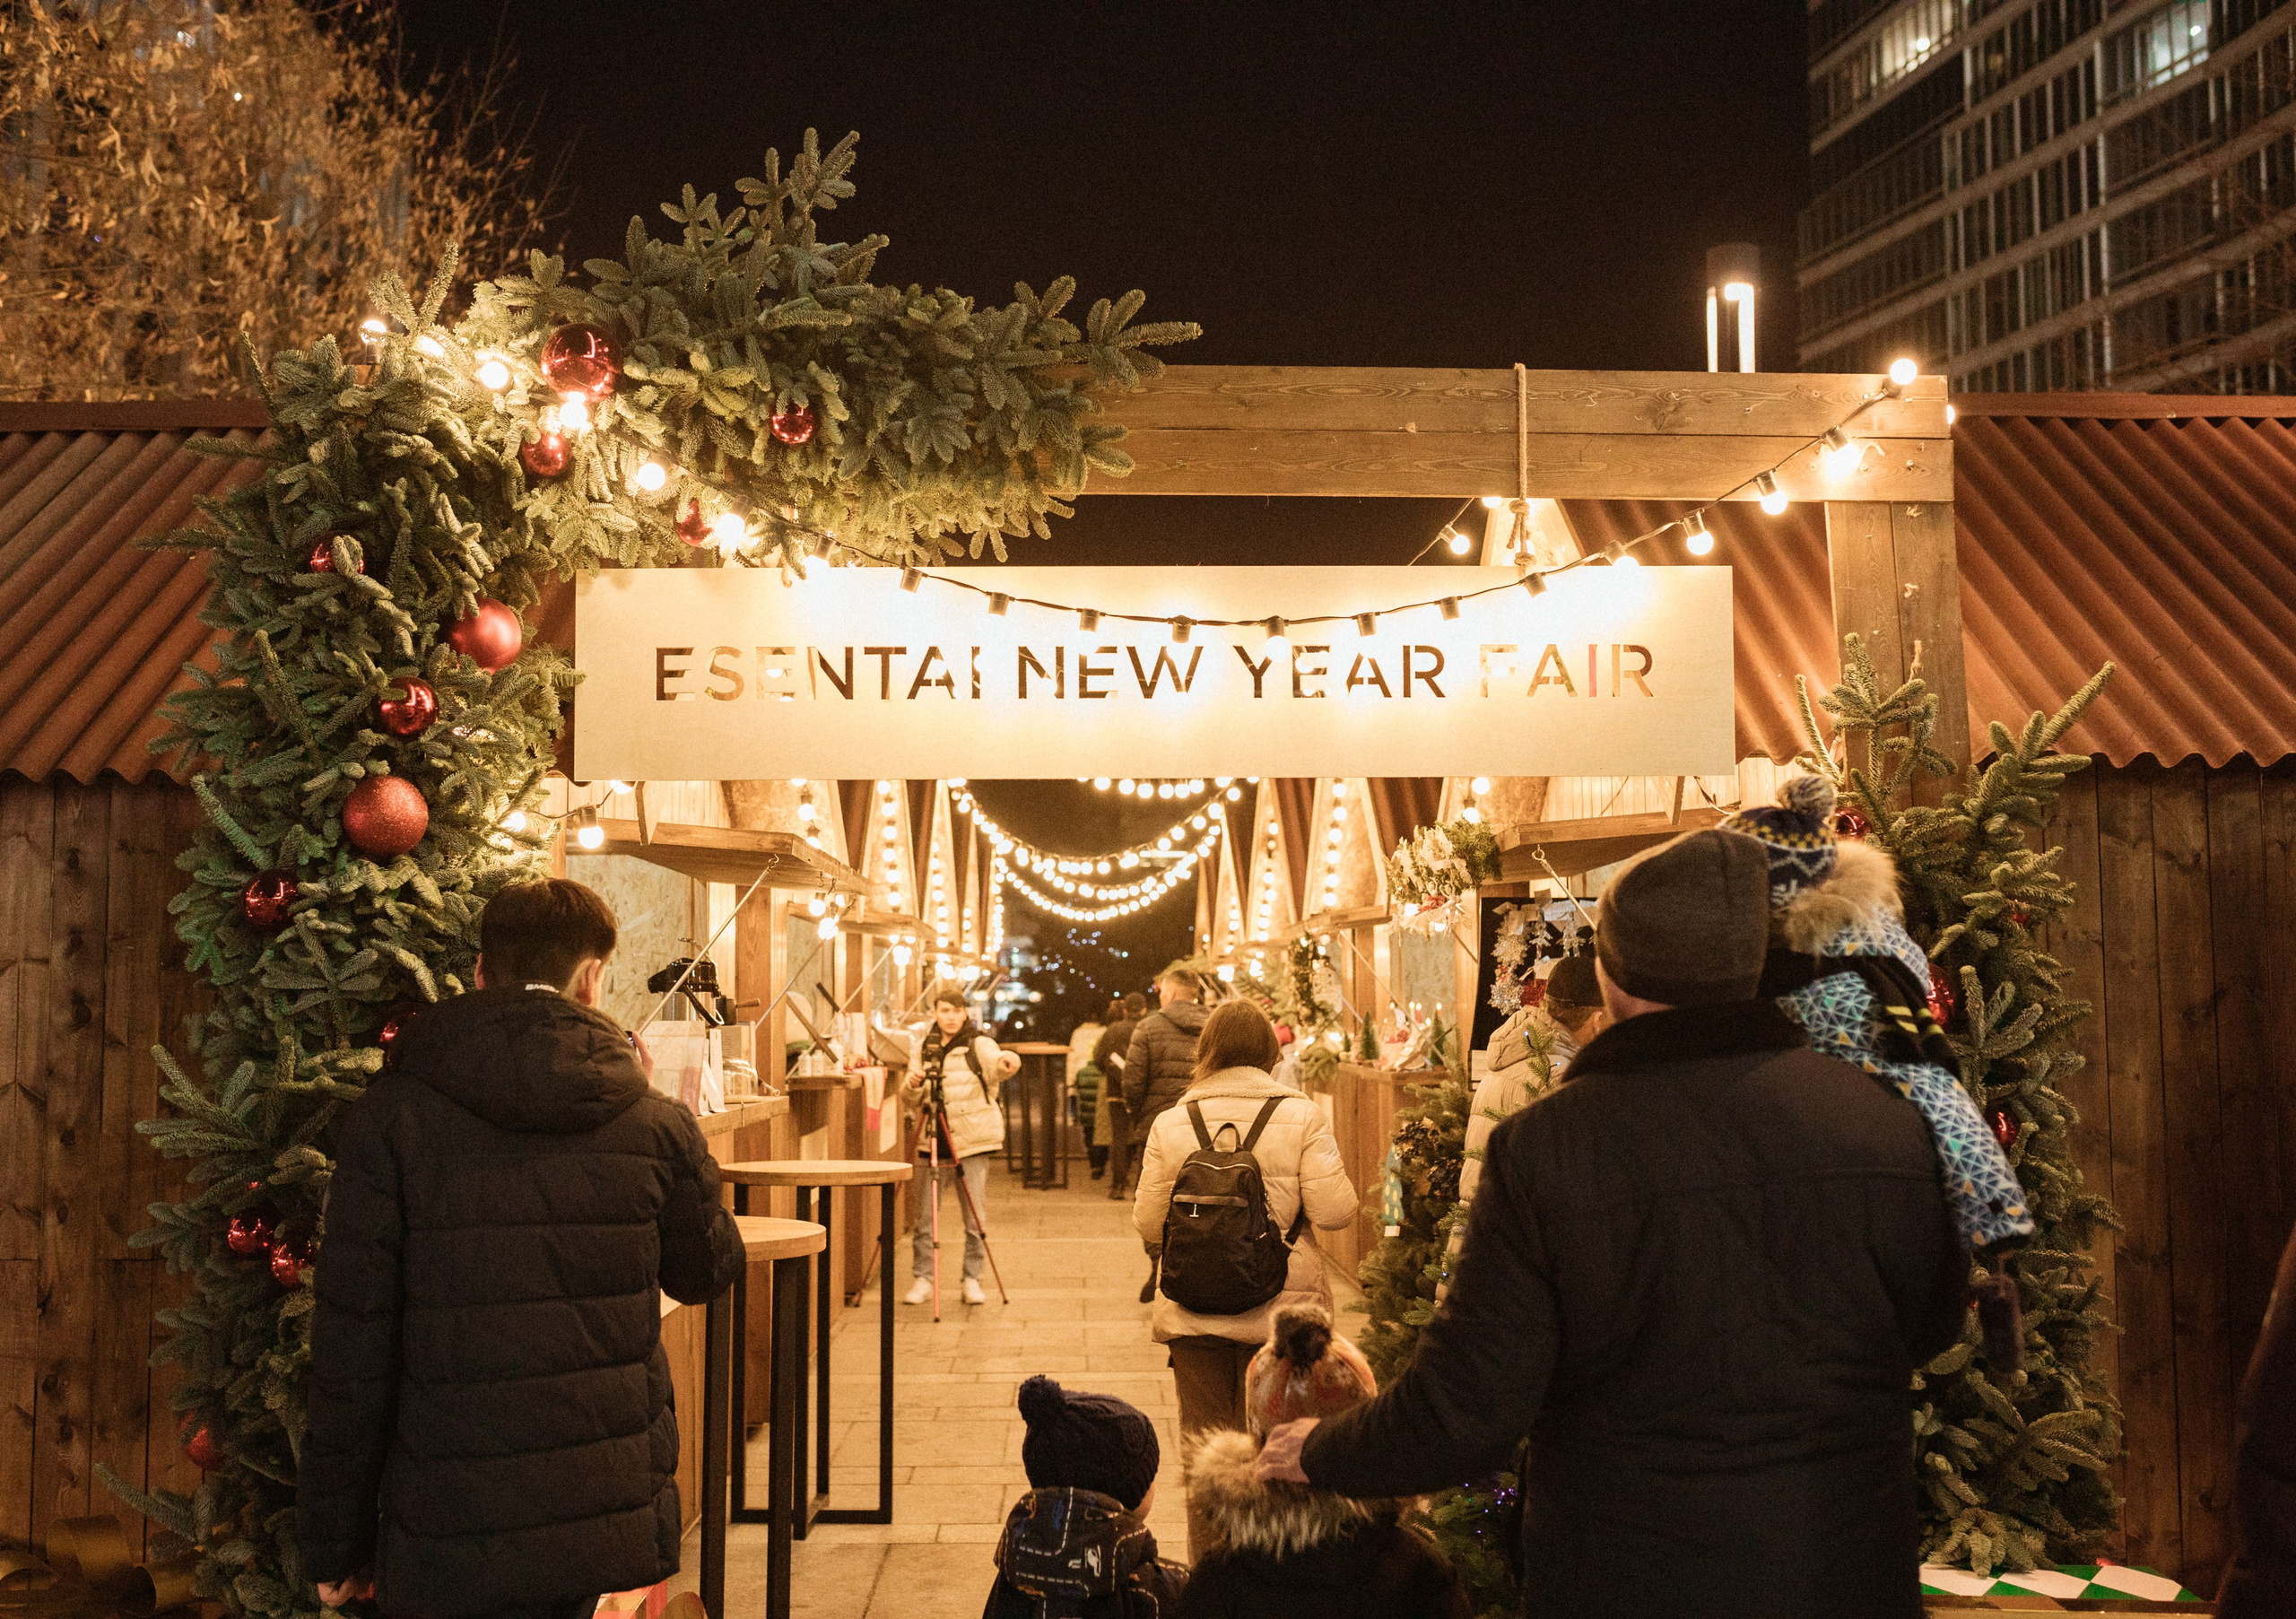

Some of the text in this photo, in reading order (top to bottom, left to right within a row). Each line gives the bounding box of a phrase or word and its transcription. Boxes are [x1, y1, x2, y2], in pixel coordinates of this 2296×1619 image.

[656, 644, 1655, 701] ESENTAI NEW YEAR FAIR
